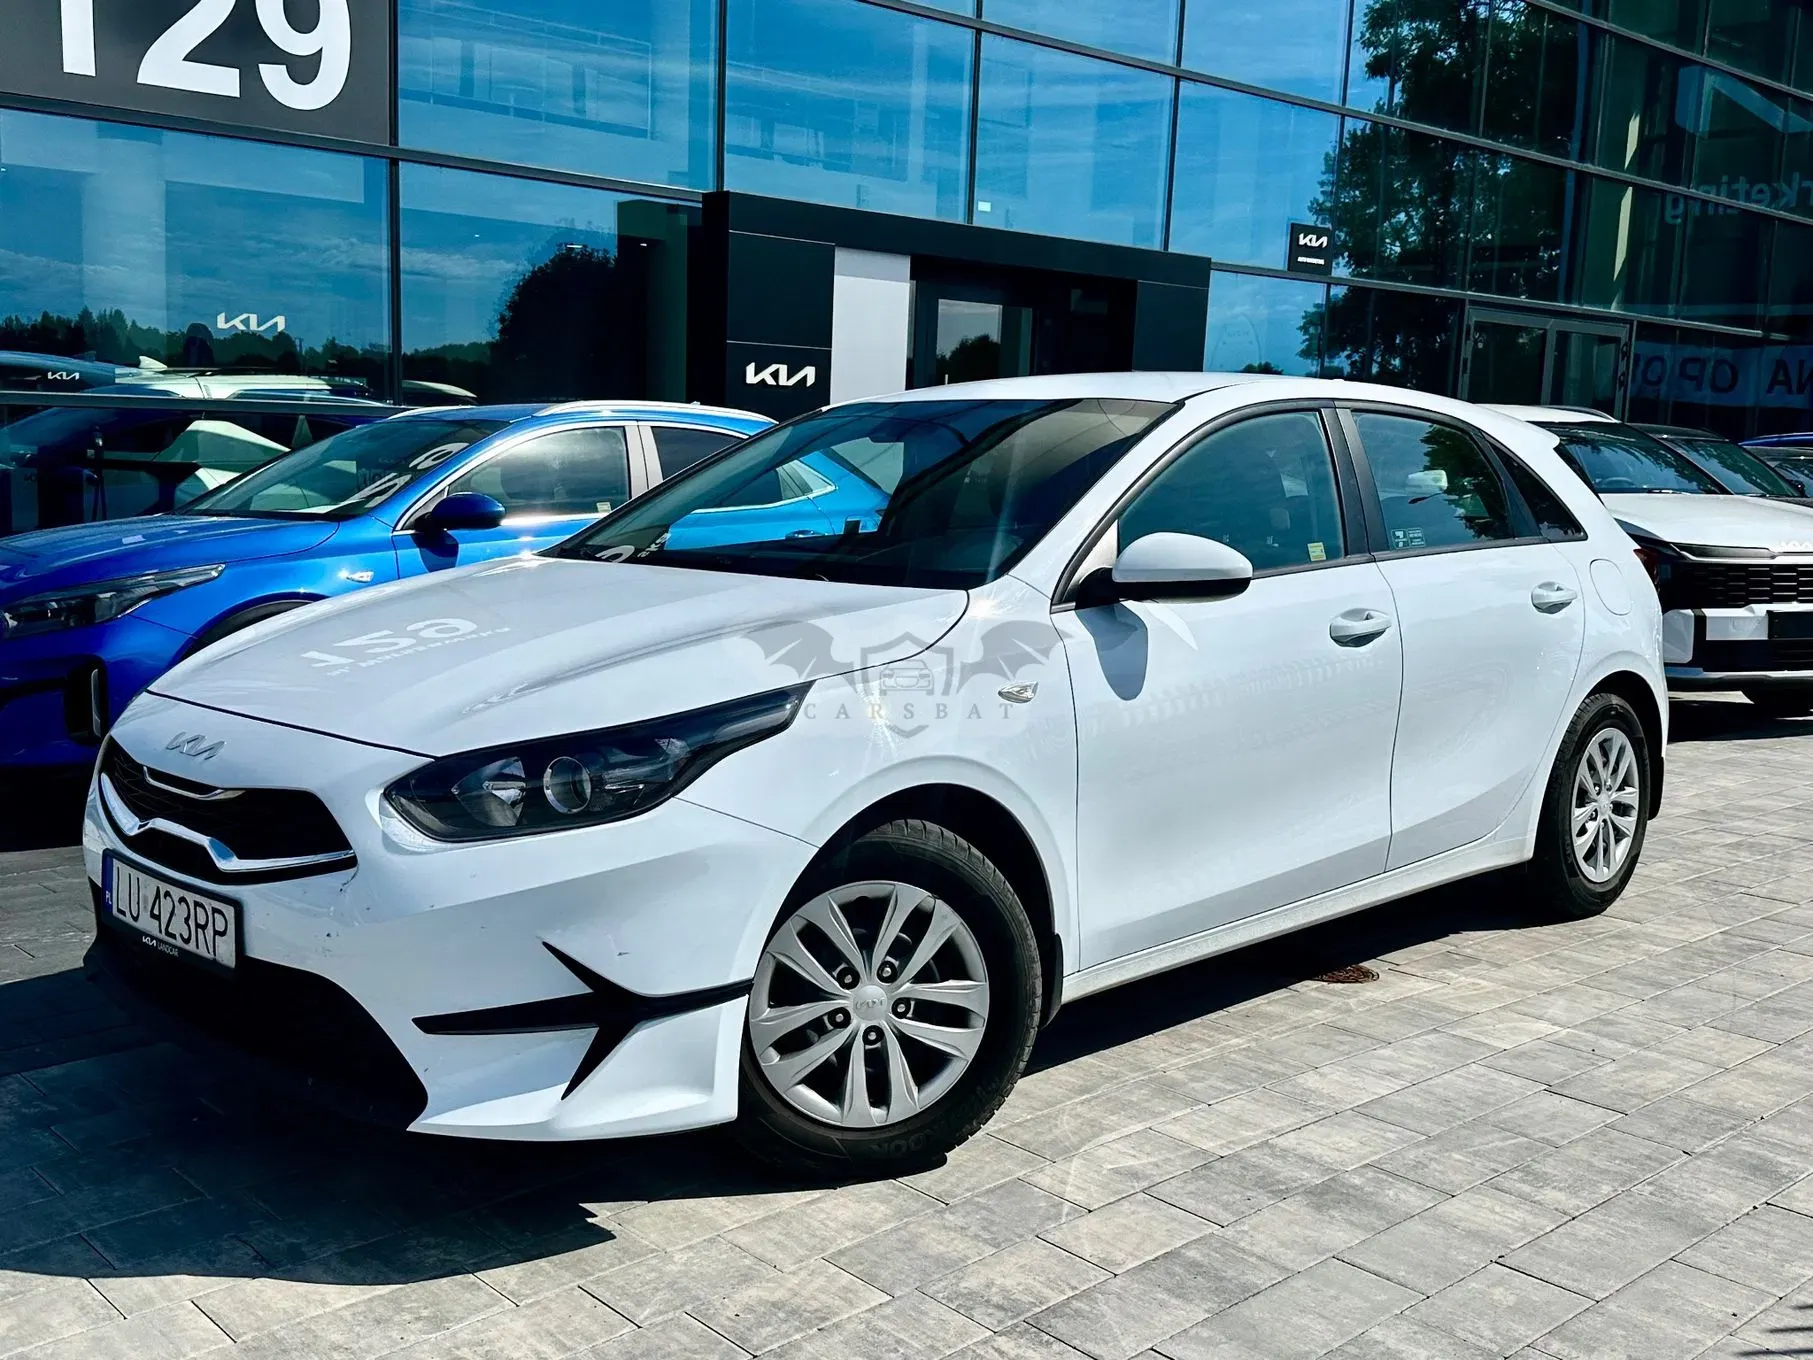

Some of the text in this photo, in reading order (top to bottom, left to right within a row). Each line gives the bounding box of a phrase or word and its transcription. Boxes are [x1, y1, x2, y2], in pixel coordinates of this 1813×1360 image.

[1299, 233, 1328, 248] KIA
[217, 312, 286, 332] KIA
[746, 362, 816, 387] KIA
[165, 731, 226, 761] KIA
[116, 866, 229, 957] LU 423RP
